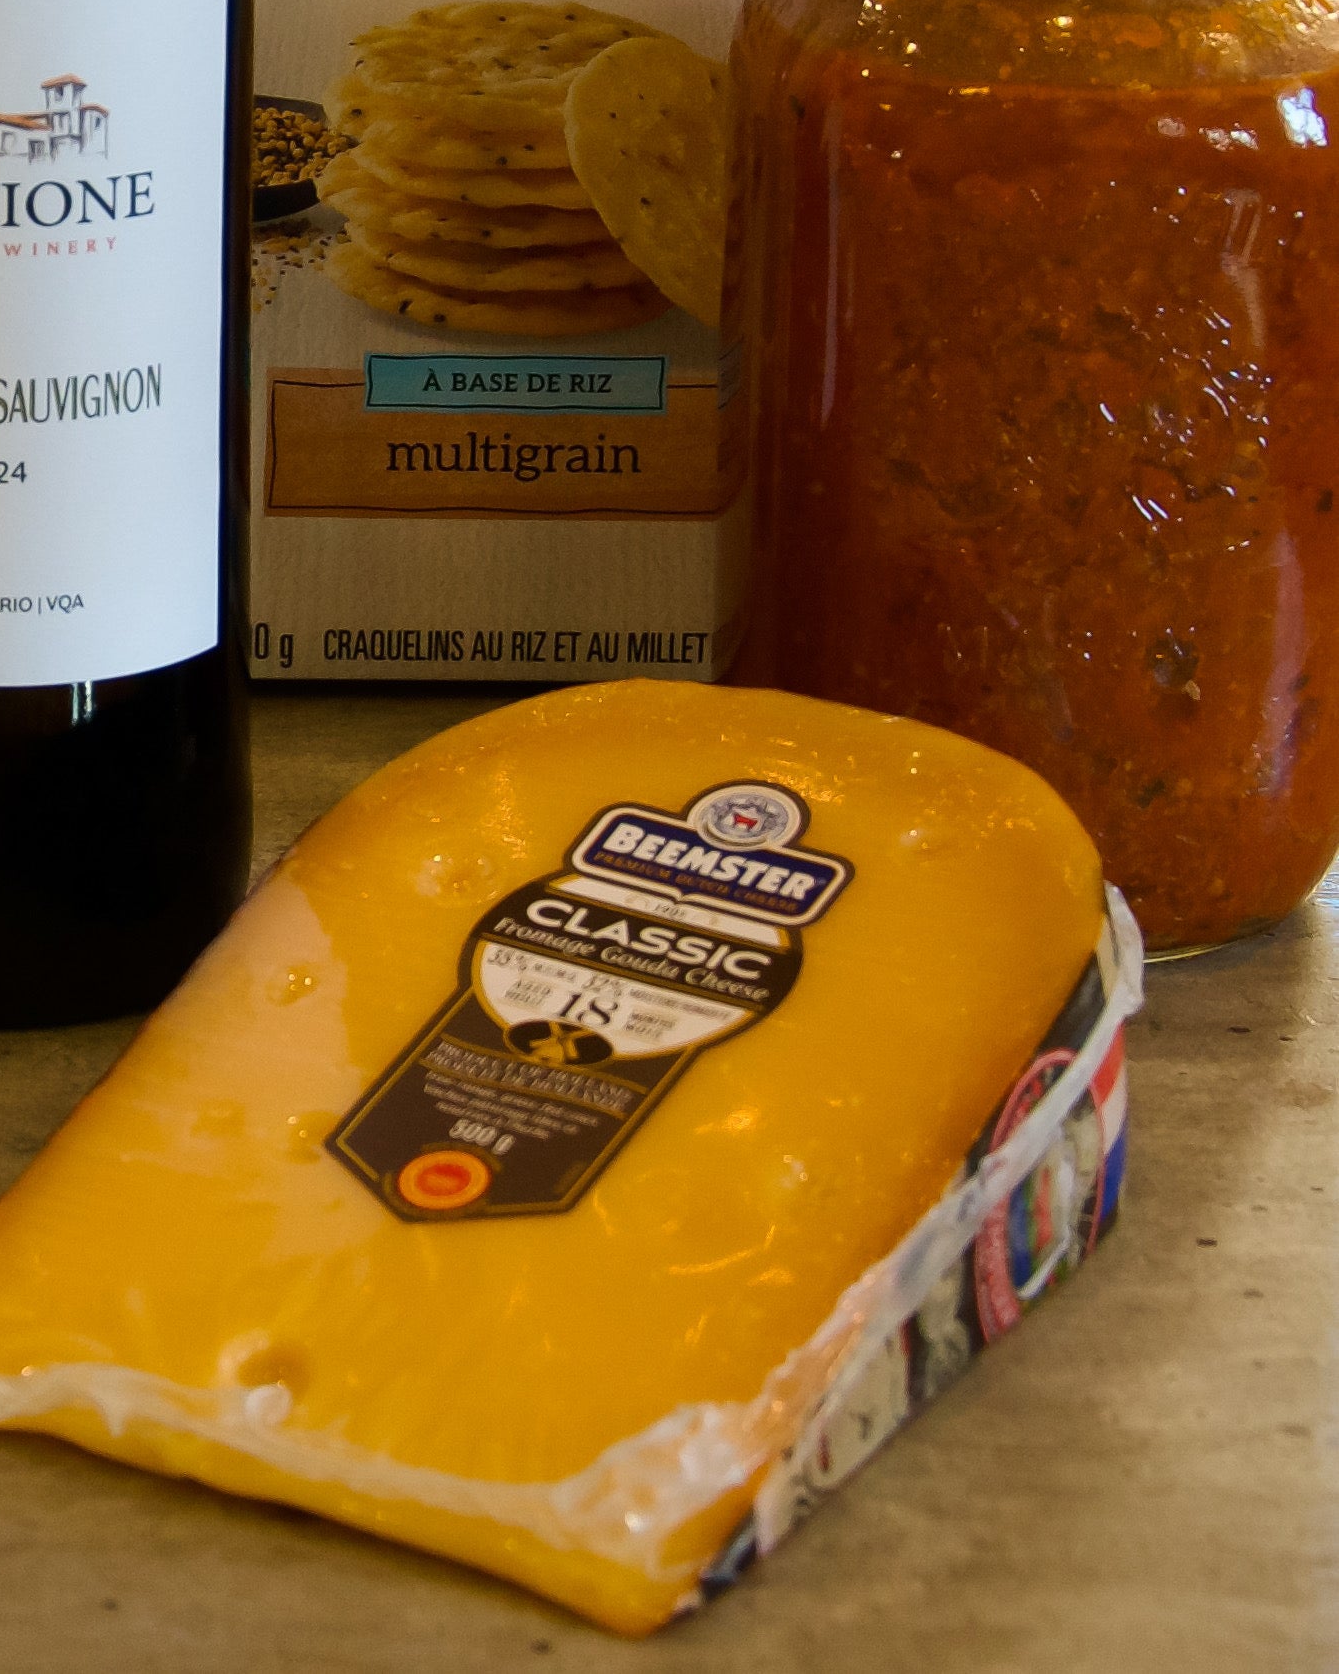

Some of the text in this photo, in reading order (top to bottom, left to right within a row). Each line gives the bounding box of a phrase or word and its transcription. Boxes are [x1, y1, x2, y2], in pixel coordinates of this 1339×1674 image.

[2, 235, 117, 258] WINERY
[421, 367, 613, 395] À BASE DE RIZ
[386, 431, 643, 483] multigrain
[45, 593, 85, 614] VQA
[254, 621, 294, 669] 0 g
[322, 628, 709, 665] CRAQUELINS AU RIZ ET AU MILLET
[602, 822, 816, 901] BEEMSTER
[493, 916, 596, 958] Fromage
[600, 945, 681, 979] Gouda
[685, 967, 771, 1000] Cheese
[525, 897, 771, 980] CLASSIC
[560, 992, 619, 1026] 18
